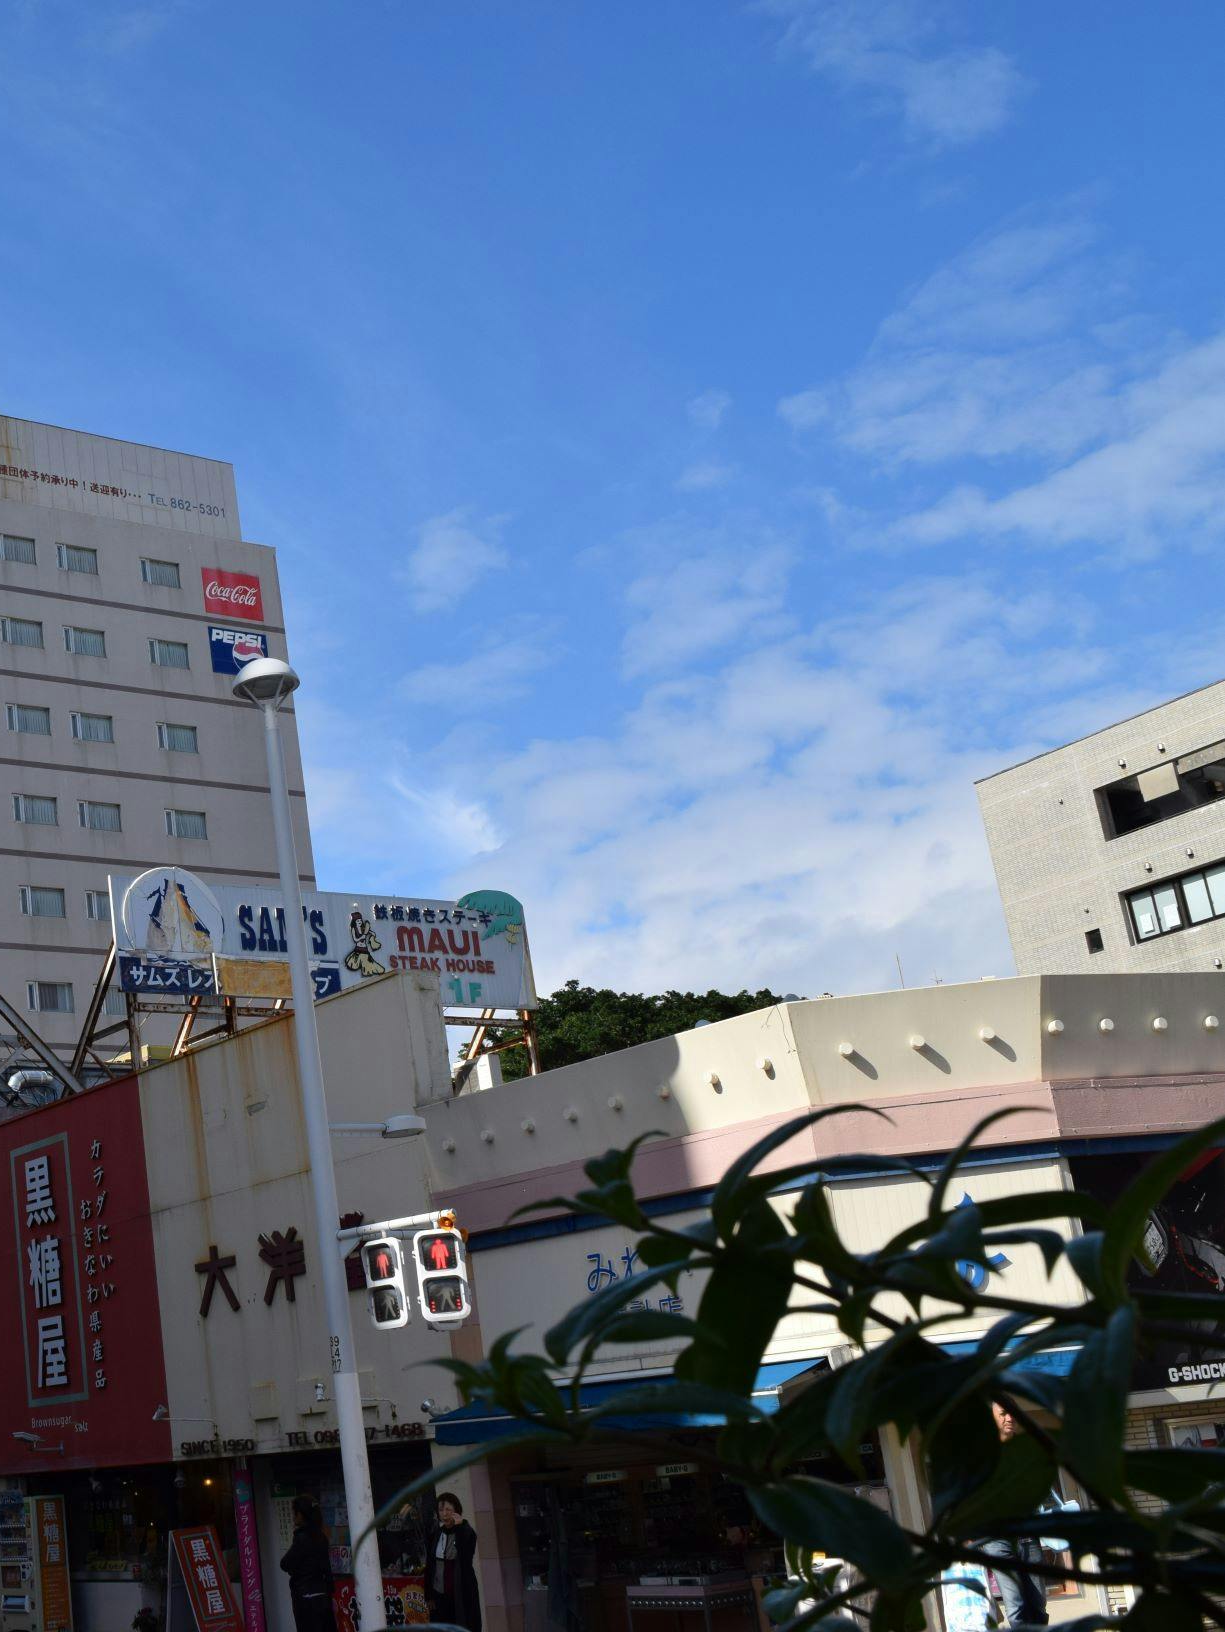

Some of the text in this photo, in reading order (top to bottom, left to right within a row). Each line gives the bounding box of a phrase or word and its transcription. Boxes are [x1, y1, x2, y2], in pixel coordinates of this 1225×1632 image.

[148, 493, 168, 507] TEL
[170, 496, 227, 519] 862-5301
[205, 580, 257, 607] Coca-Cola
[211, 628, 263, 650] PEPSI
[373, 903, 492, 929] 鉄板焼きステーキ
[396, 925, 481, 957] MAUI
[129, 966, 181, 987] サムズ
[389, 954, 496, 975] STEAK HOUSE
[448, 978, 482, 1003] 1F
[89, 1138, 116, 1299] カラダにいい
[24, 1155, 70, 1388] 黒糖屋
[80, 1199, 108, 1389] おきなわ県産品
[180, 1438, 255, 1457] SINCE 1950
[285, 1431, 312, 1447] TEL
[190, 1538, 226, 1614] 黒糖屋
